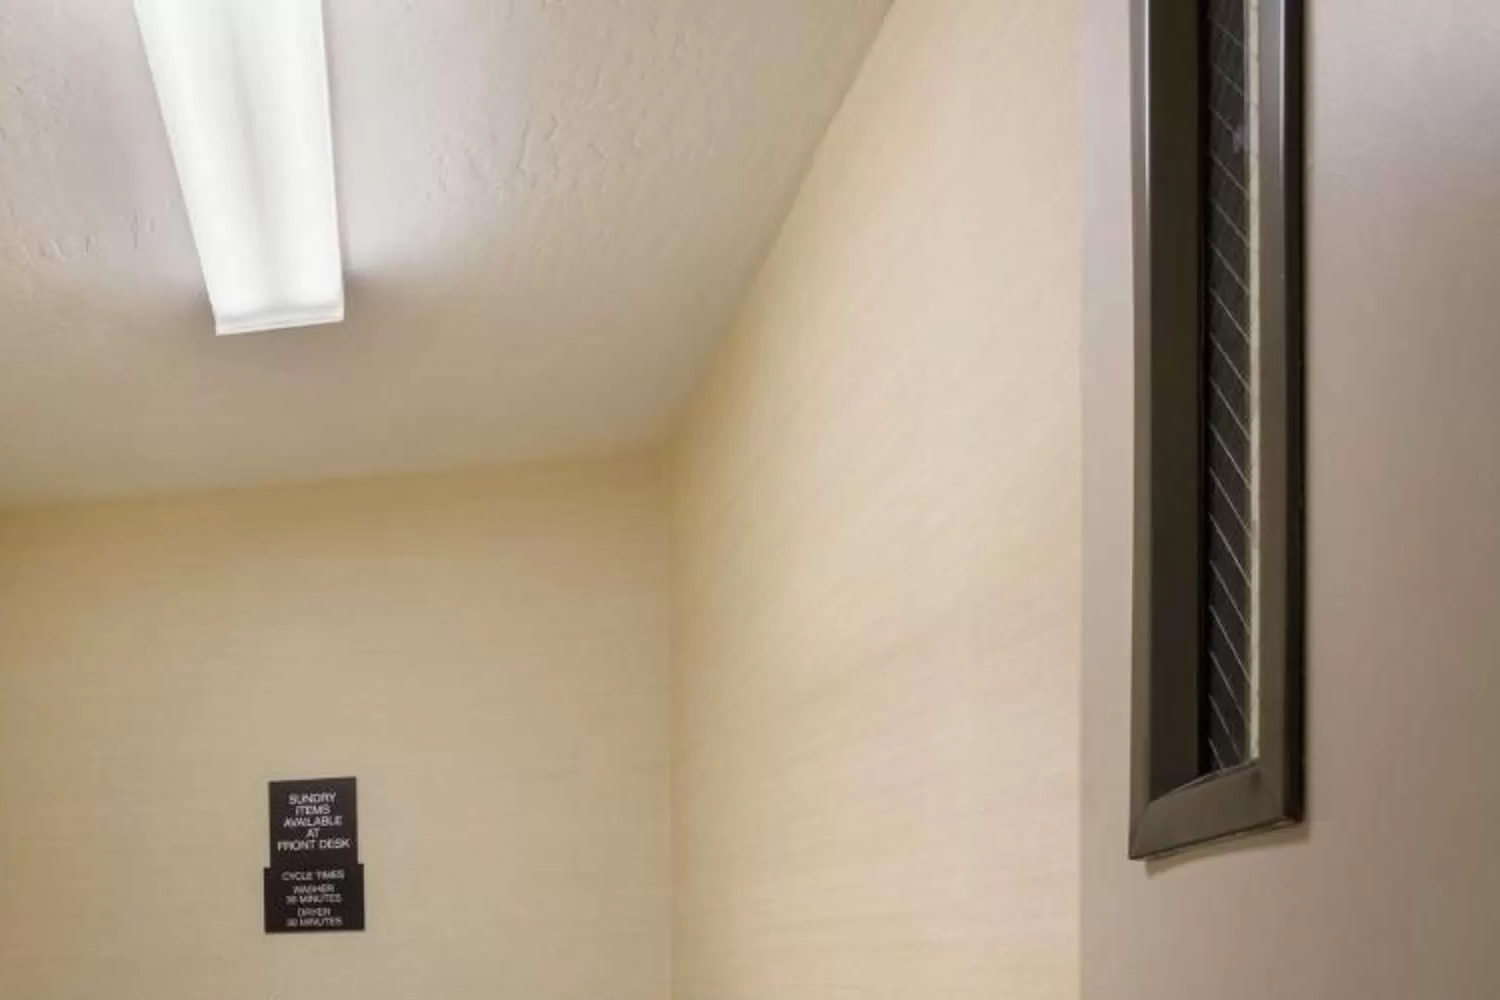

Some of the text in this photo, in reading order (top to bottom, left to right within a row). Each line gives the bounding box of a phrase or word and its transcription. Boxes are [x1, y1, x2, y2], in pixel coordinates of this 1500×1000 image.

[288, 791, 337, 805] SUNDRY
[295, 804, 331, 815] ITEMS
[283, 815, 343, 828] AVAILABLE
[306, 827, 320, 838] AT
[277, 837, 350, 851] FRONT DESK
[299, 893, 342, 904] MINUTES
[299, 916, 343, 927] MINUTES
